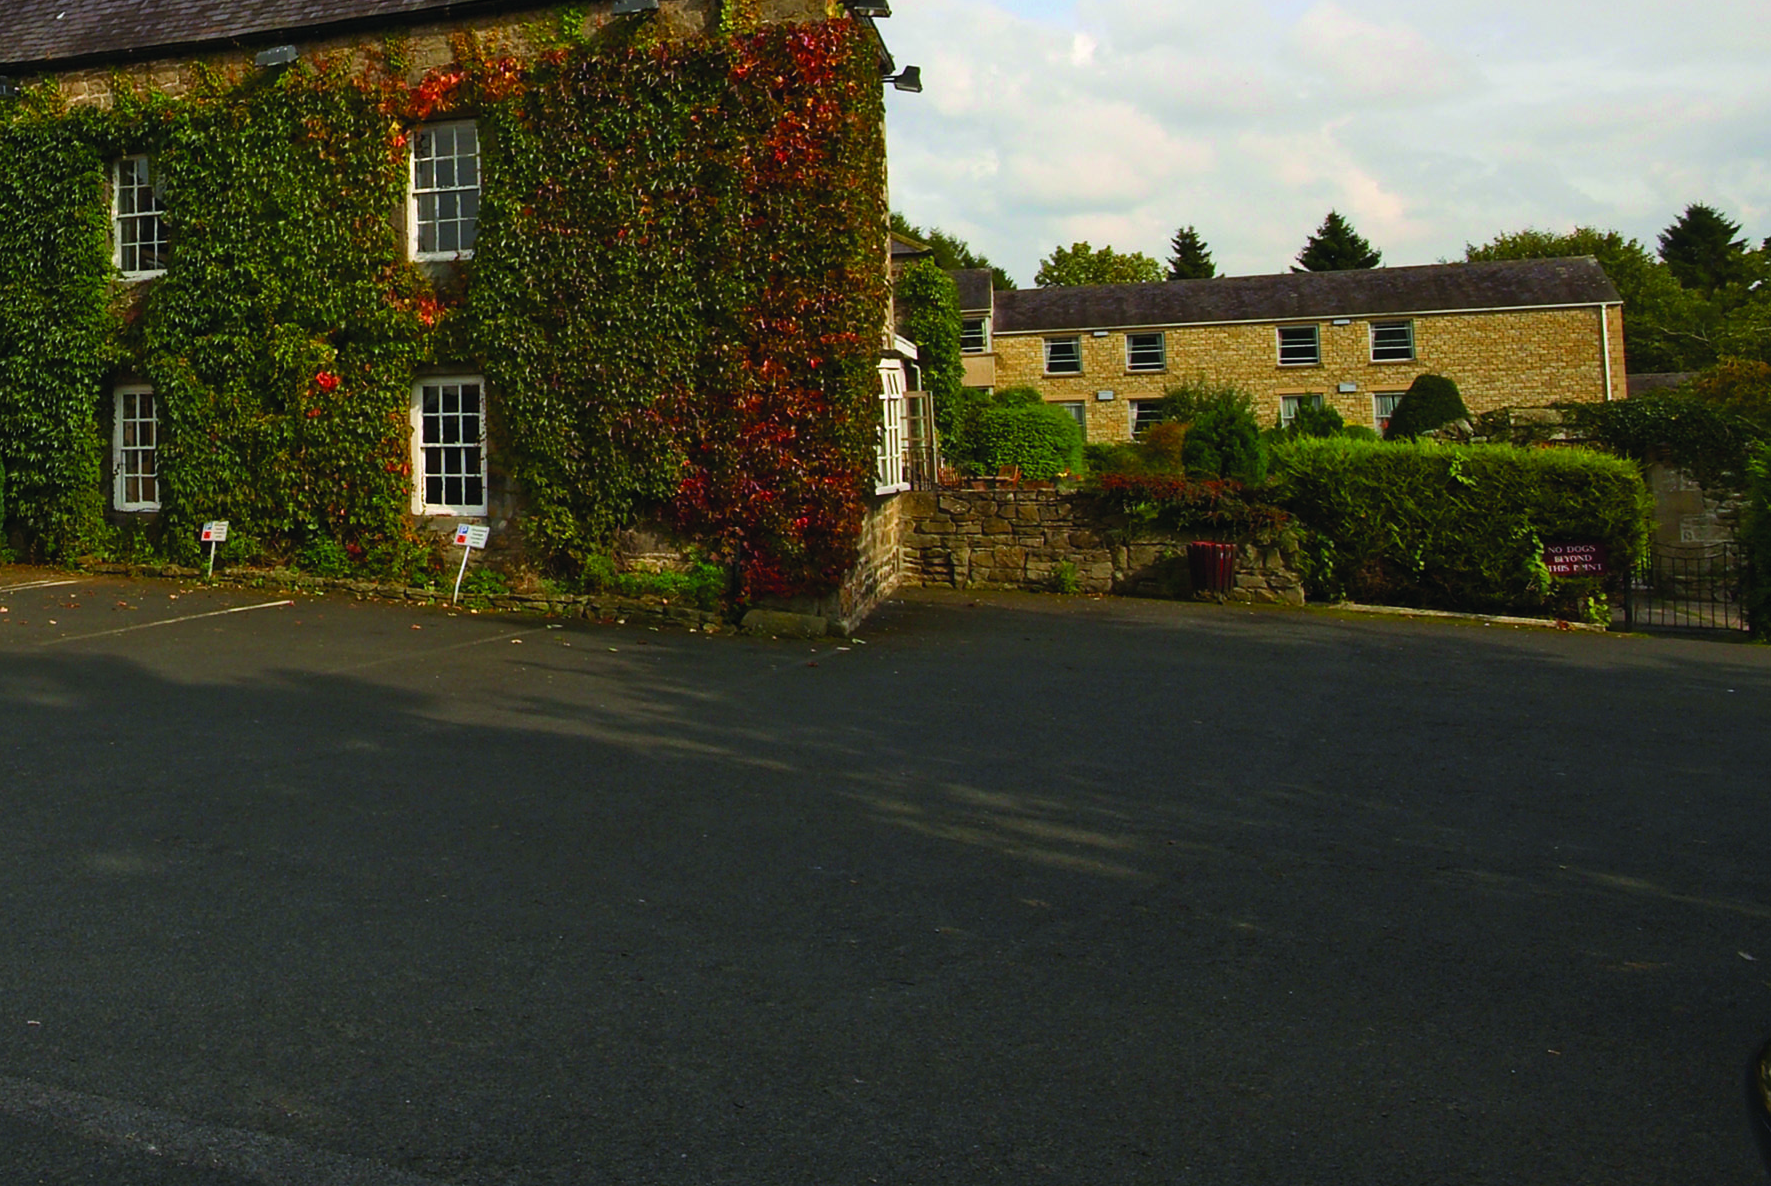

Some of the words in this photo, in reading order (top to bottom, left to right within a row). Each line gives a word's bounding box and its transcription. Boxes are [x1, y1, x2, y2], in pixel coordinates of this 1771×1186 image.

[1548, 546, 1562, 554] NO
[1566, 545, 1596, 553] DOGS
[1548, 564, 1570, 573] THIS
[1573, 563, 1603, 572] PINT
